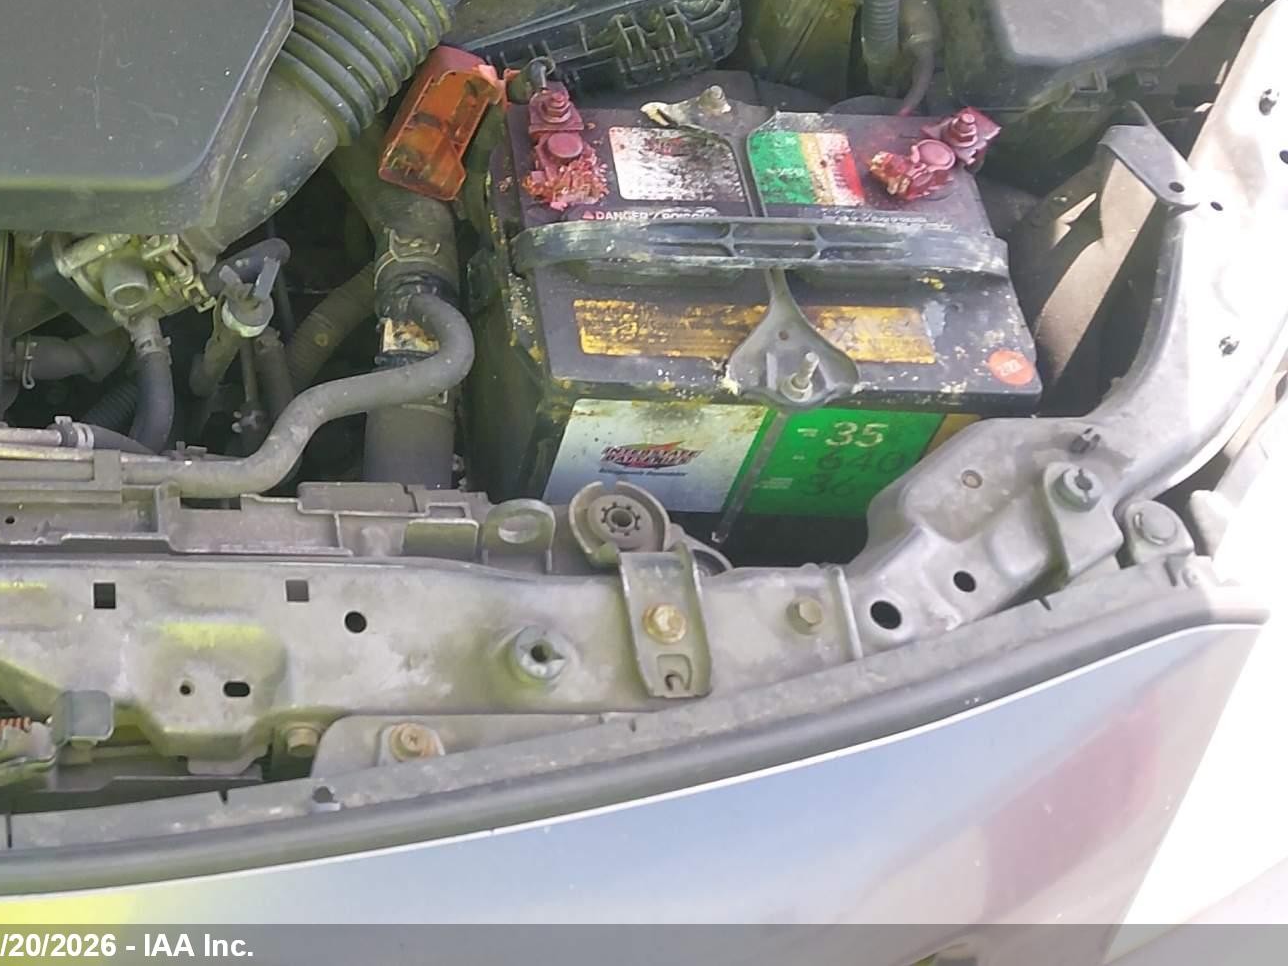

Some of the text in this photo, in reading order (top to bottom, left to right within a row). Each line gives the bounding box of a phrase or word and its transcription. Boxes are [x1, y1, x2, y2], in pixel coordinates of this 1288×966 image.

[595, 210, 649, 221] DANGER
[824, 421, 889, 448] 35
[816, 446, 905, 474] 640
